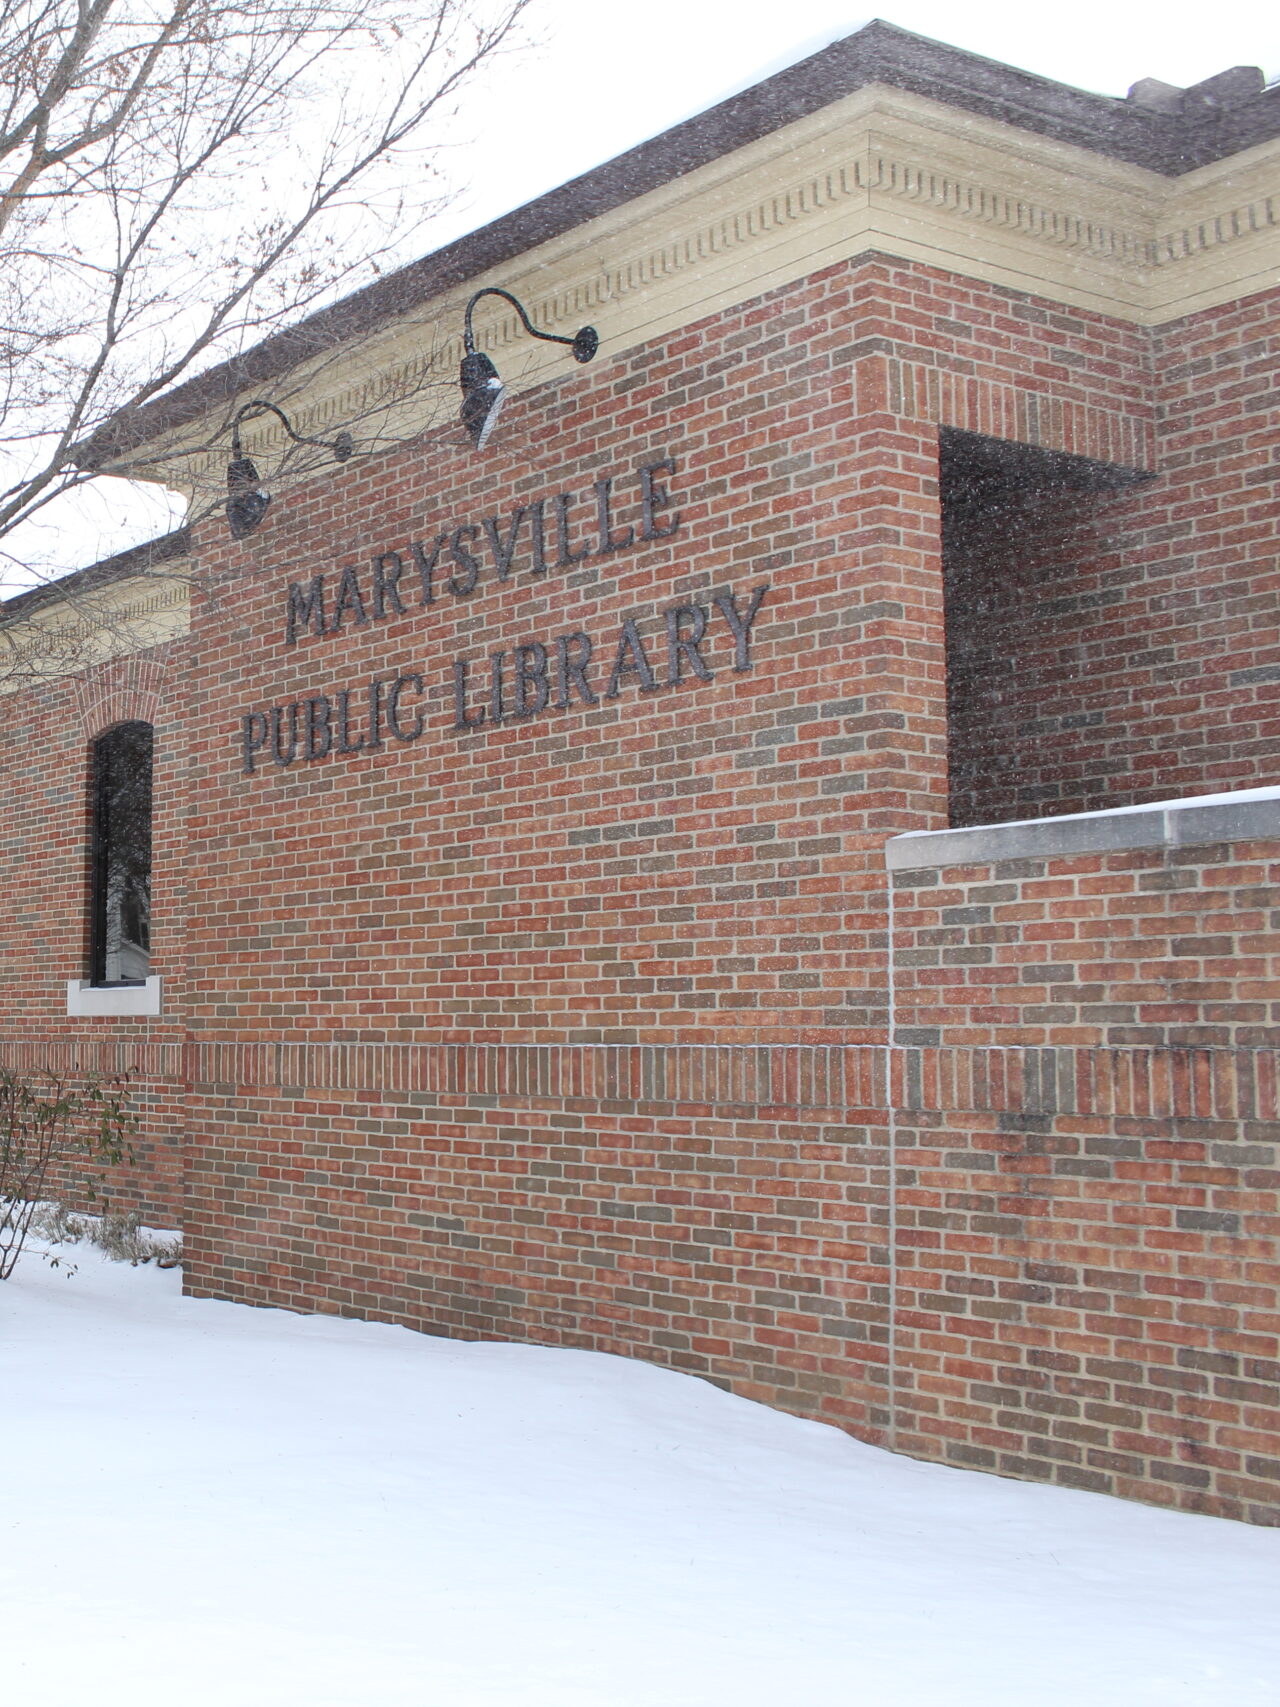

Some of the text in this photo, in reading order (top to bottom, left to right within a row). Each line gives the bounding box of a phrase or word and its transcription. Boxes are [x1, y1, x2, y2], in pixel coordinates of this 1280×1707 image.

[286, 458, 681, 645] MARYSVILLE
[243, 584, 770, 774] PUBLIC LIBRARY
